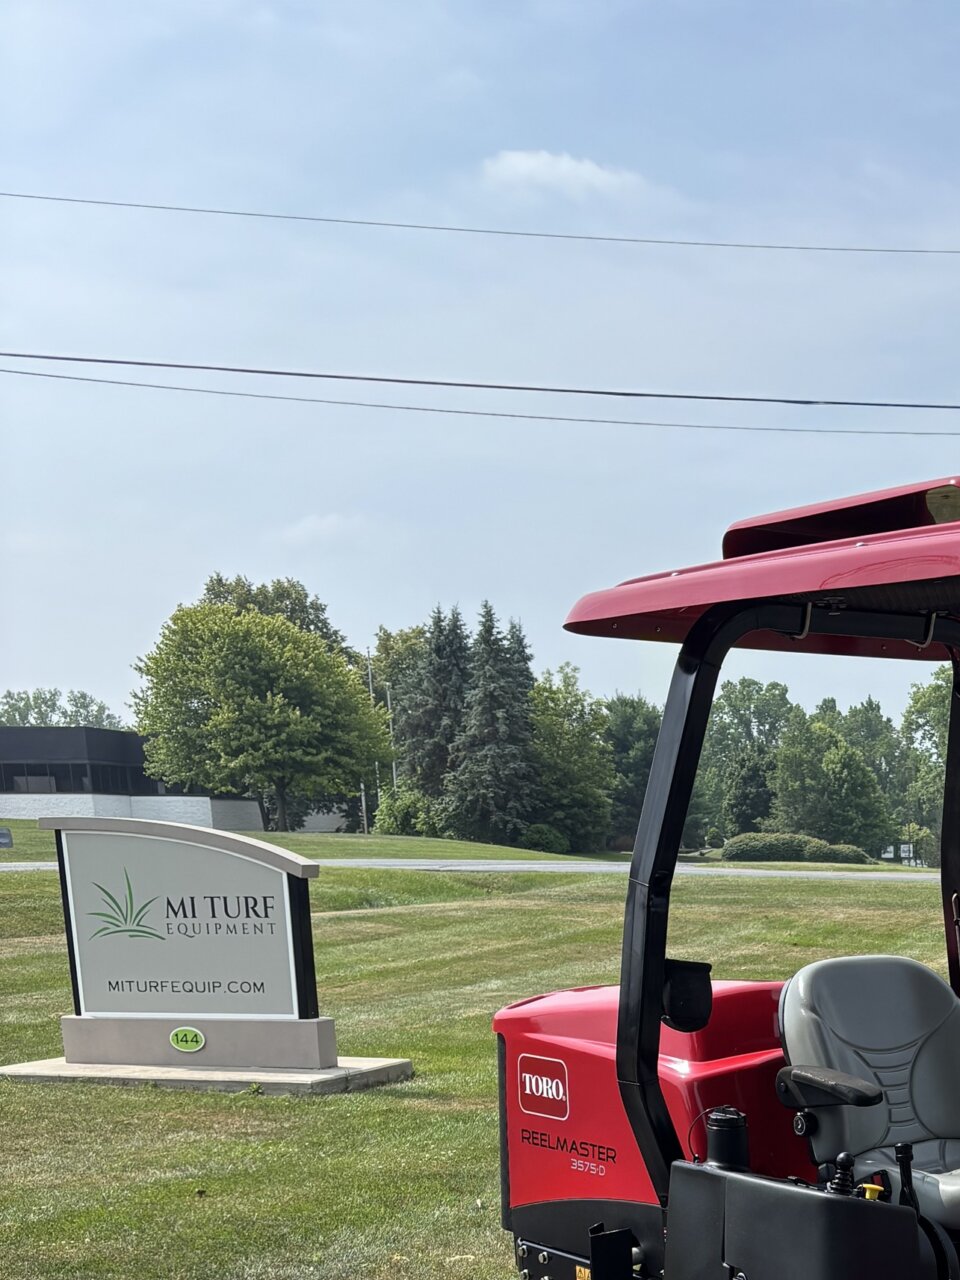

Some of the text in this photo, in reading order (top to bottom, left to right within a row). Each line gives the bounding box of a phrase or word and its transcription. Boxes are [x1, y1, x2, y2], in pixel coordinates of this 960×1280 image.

[166, 895, 275, 919] MI TURF
[166, 922, 276, 938] EQUIPMENT
[108, 980, 265, 994] MITURFEQUIP.COM
[174, 1032, 200, 1045] 144
[522, 1073, 564, 1101] TORO
[521, 1128, 617, 1164] REELMASTER
